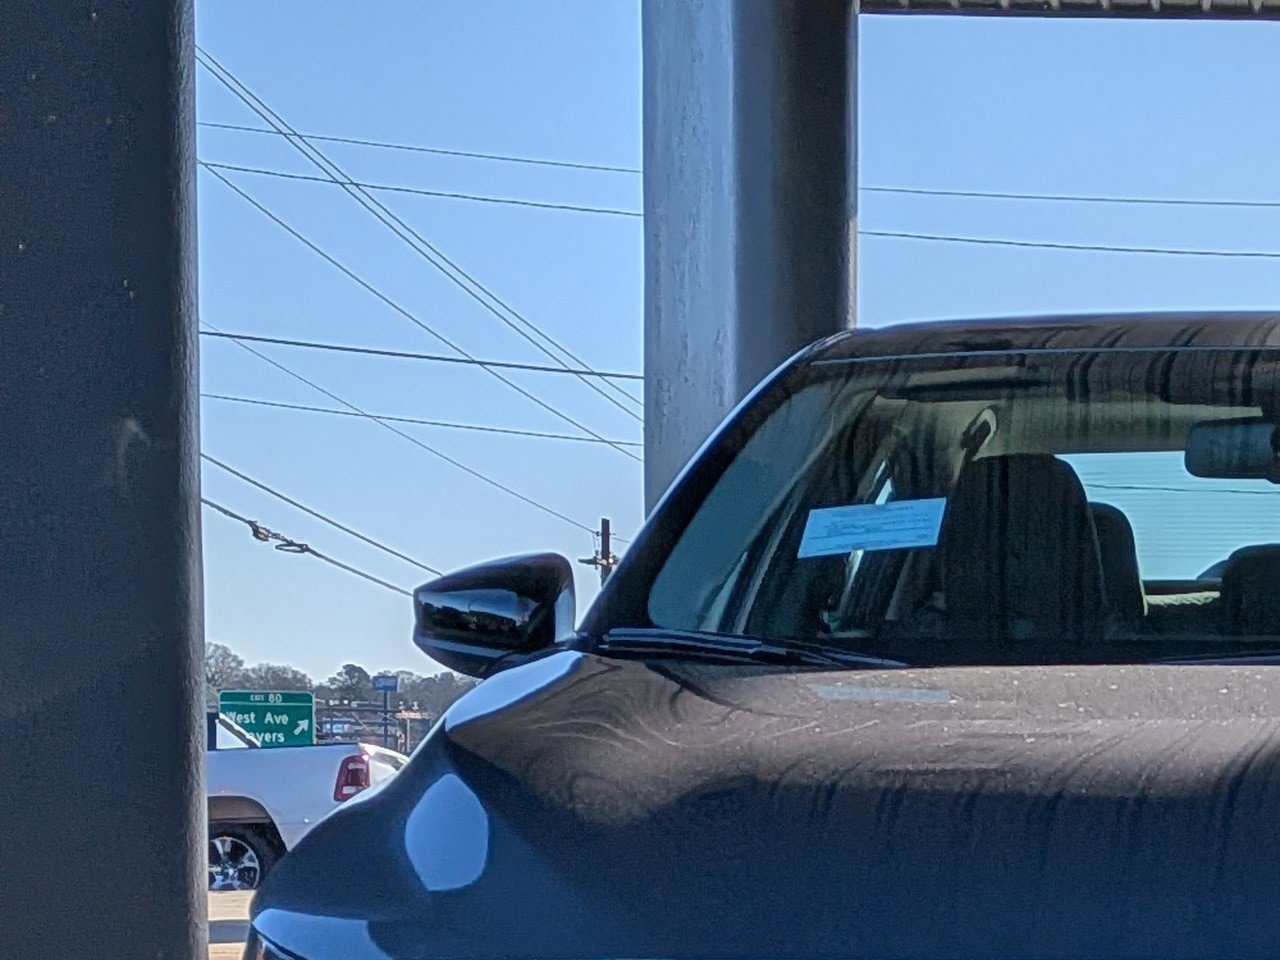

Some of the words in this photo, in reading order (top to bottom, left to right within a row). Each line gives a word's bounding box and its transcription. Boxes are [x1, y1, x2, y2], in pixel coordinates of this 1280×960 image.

[268, 693, 283, 703] 80
[226, 711, 256, 724] West
[264, 711, 289, 725] Ave
